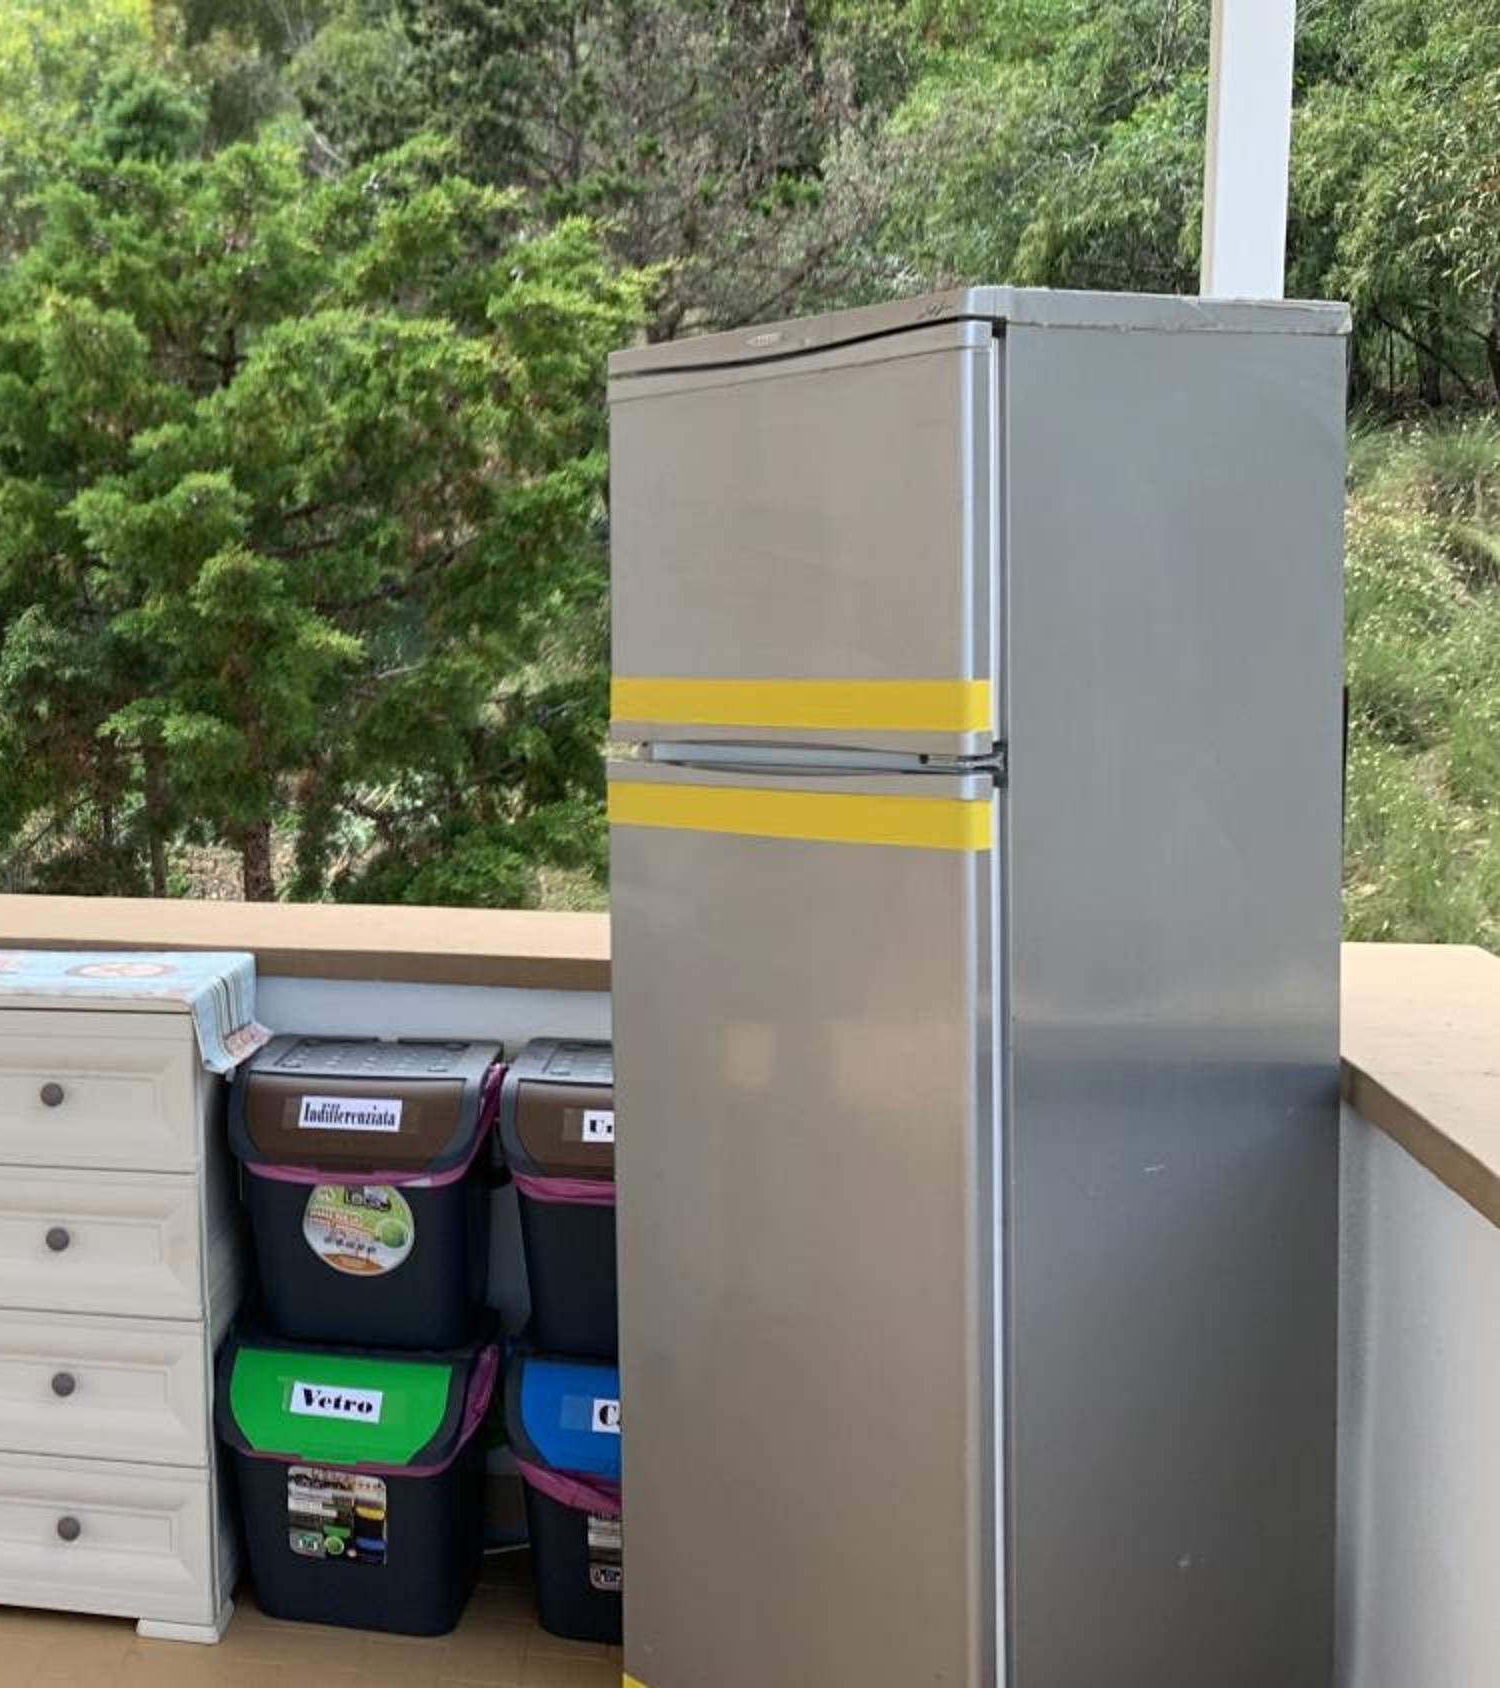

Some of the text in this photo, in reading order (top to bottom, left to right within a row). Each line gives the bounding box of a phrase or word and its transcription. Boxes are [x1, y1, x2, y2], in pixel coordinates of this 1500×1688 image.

[304, 1102, 395, 1127] Indifferenziata
[303, 1388, 373, 1413] Vetro
[599, 1404, 621, 1426] C
